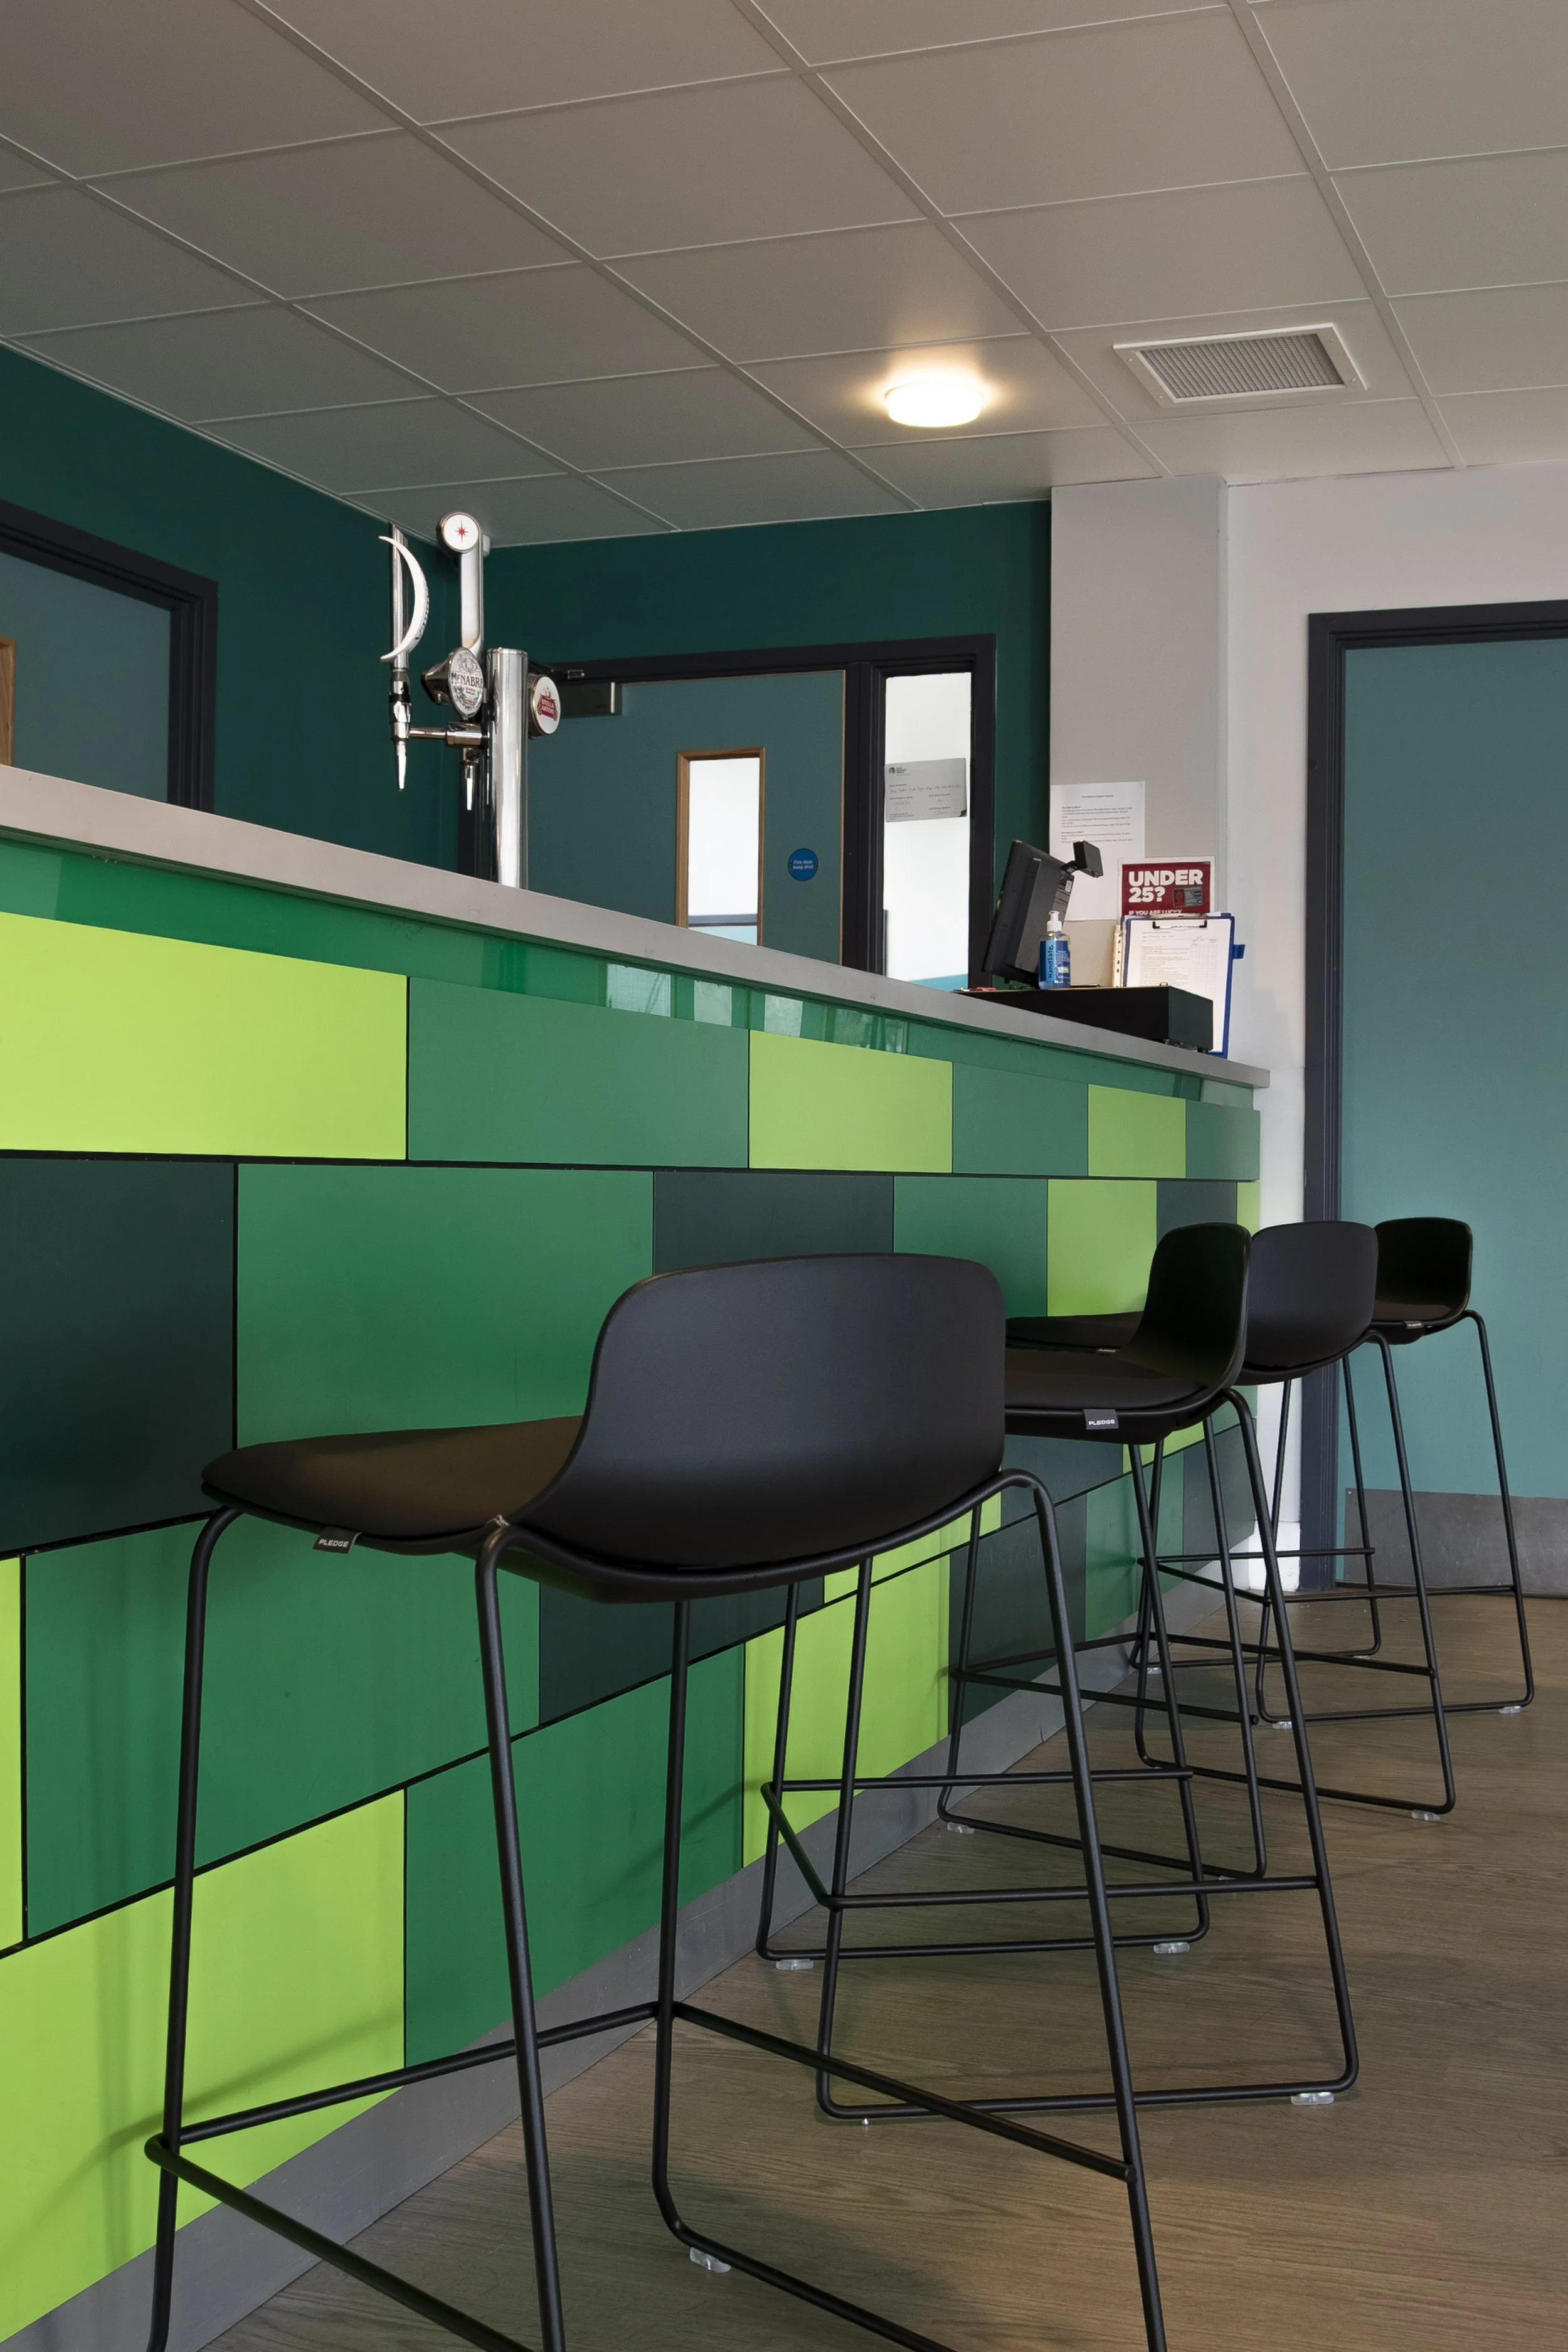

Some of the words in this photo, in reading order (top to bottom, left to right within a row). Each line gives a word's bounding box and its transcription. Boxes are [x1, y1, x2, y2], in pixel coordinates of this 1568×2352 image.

[1128, 869, 1204, 887] UNDER
[1128, 886, 1165, 903] 25?
[318, 1539, 349, 1548] PLEDGE
